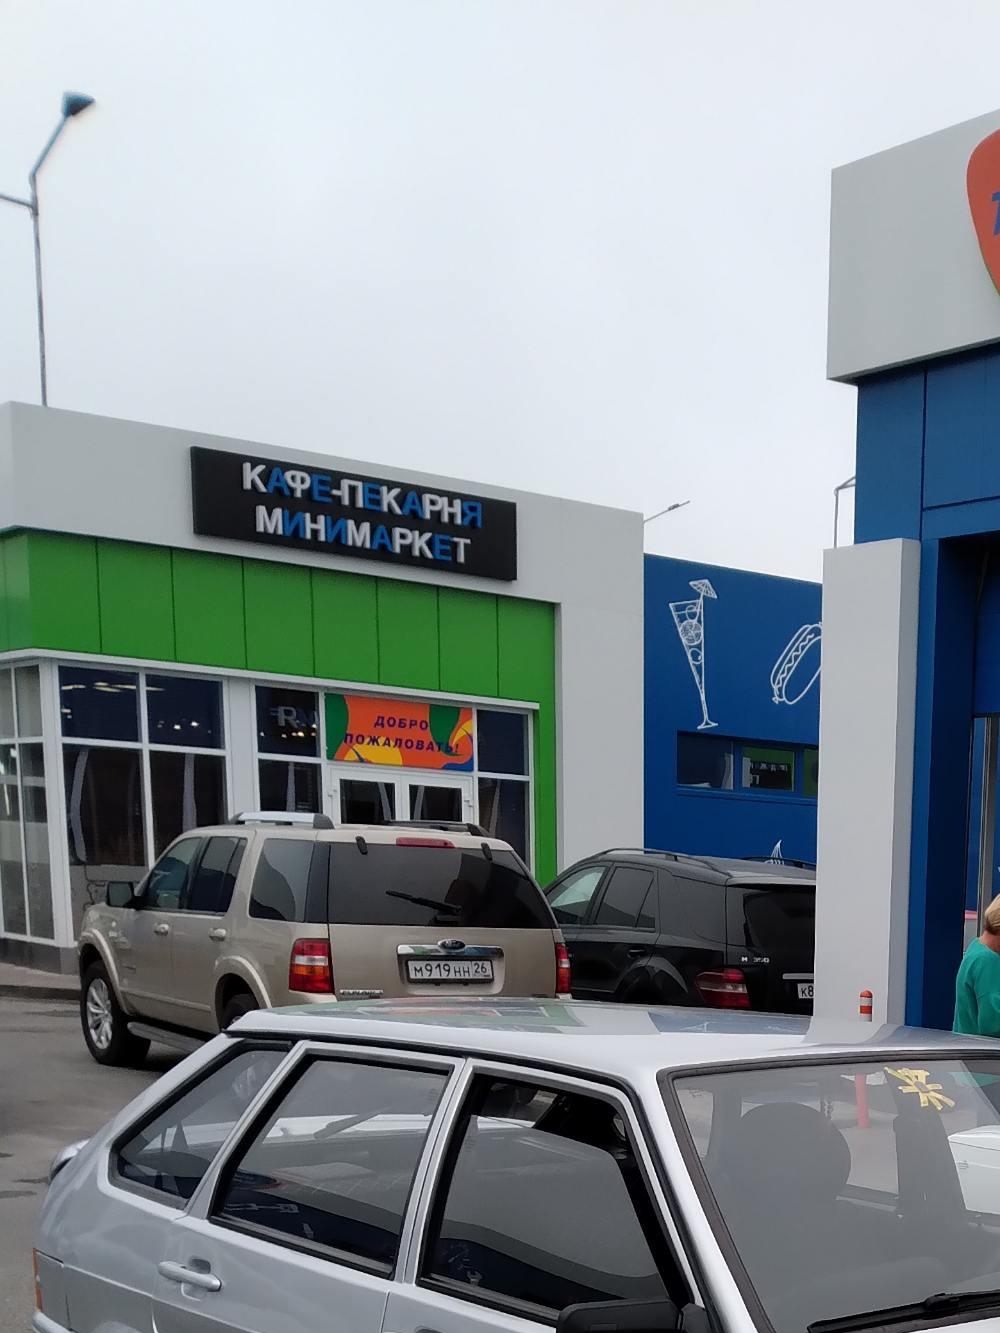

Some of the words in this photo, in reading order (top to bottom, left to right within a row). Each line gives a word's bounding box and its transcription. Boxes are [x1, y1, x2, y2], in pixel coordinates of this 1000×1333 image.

[242, 462, 482, 528] КАФЕ-ПЕКАРНЯ
[255, 504, 471, 564] МИНИМАРКЕТ
[373, 715, 429, 730] ДОБРО
[343, 732, 459, 754] ПОЖАЛОВАТЬ!
[413, 962, 470, 978] М919НН
[473, 962, 487, 974] 26
